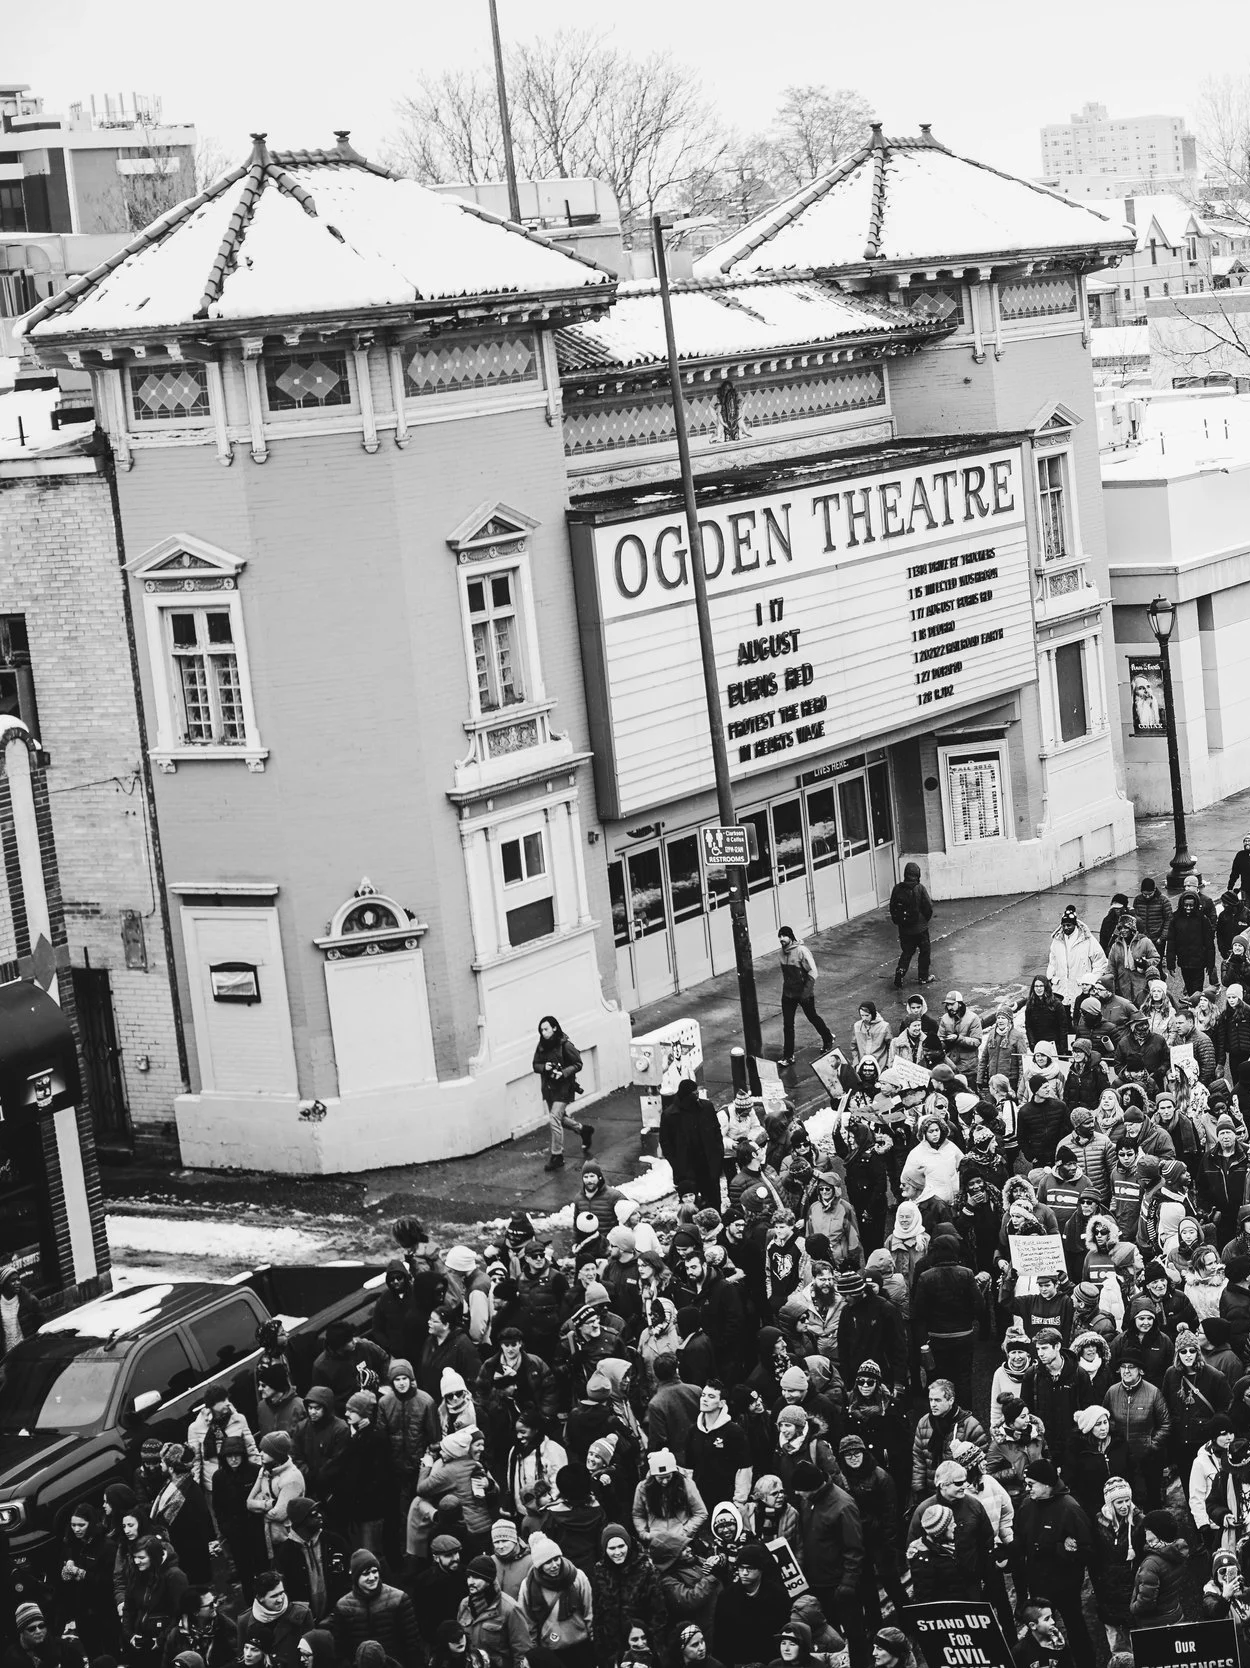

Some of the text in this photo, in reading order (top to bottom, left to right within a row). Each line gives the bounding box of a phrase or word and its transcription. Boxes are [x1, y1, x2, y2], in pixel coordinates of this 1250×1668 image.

[614, 459, 1016, 599] OGDEN THEATRE
[737, 628, 801, 666] AUGUST
[727, 662, 814, 708] BURNS RED
[728, 694, 828, 740] PROTEST THE HERO
[814, 766, 830, 778] LIVES
[916, 1615, 991, 1631] STAND UP
[948, 1633, 973, 1646] FOR
[1174, 1641, 1196, 1654] OUR
[943, 1647, 991, 1665] CIVIL
